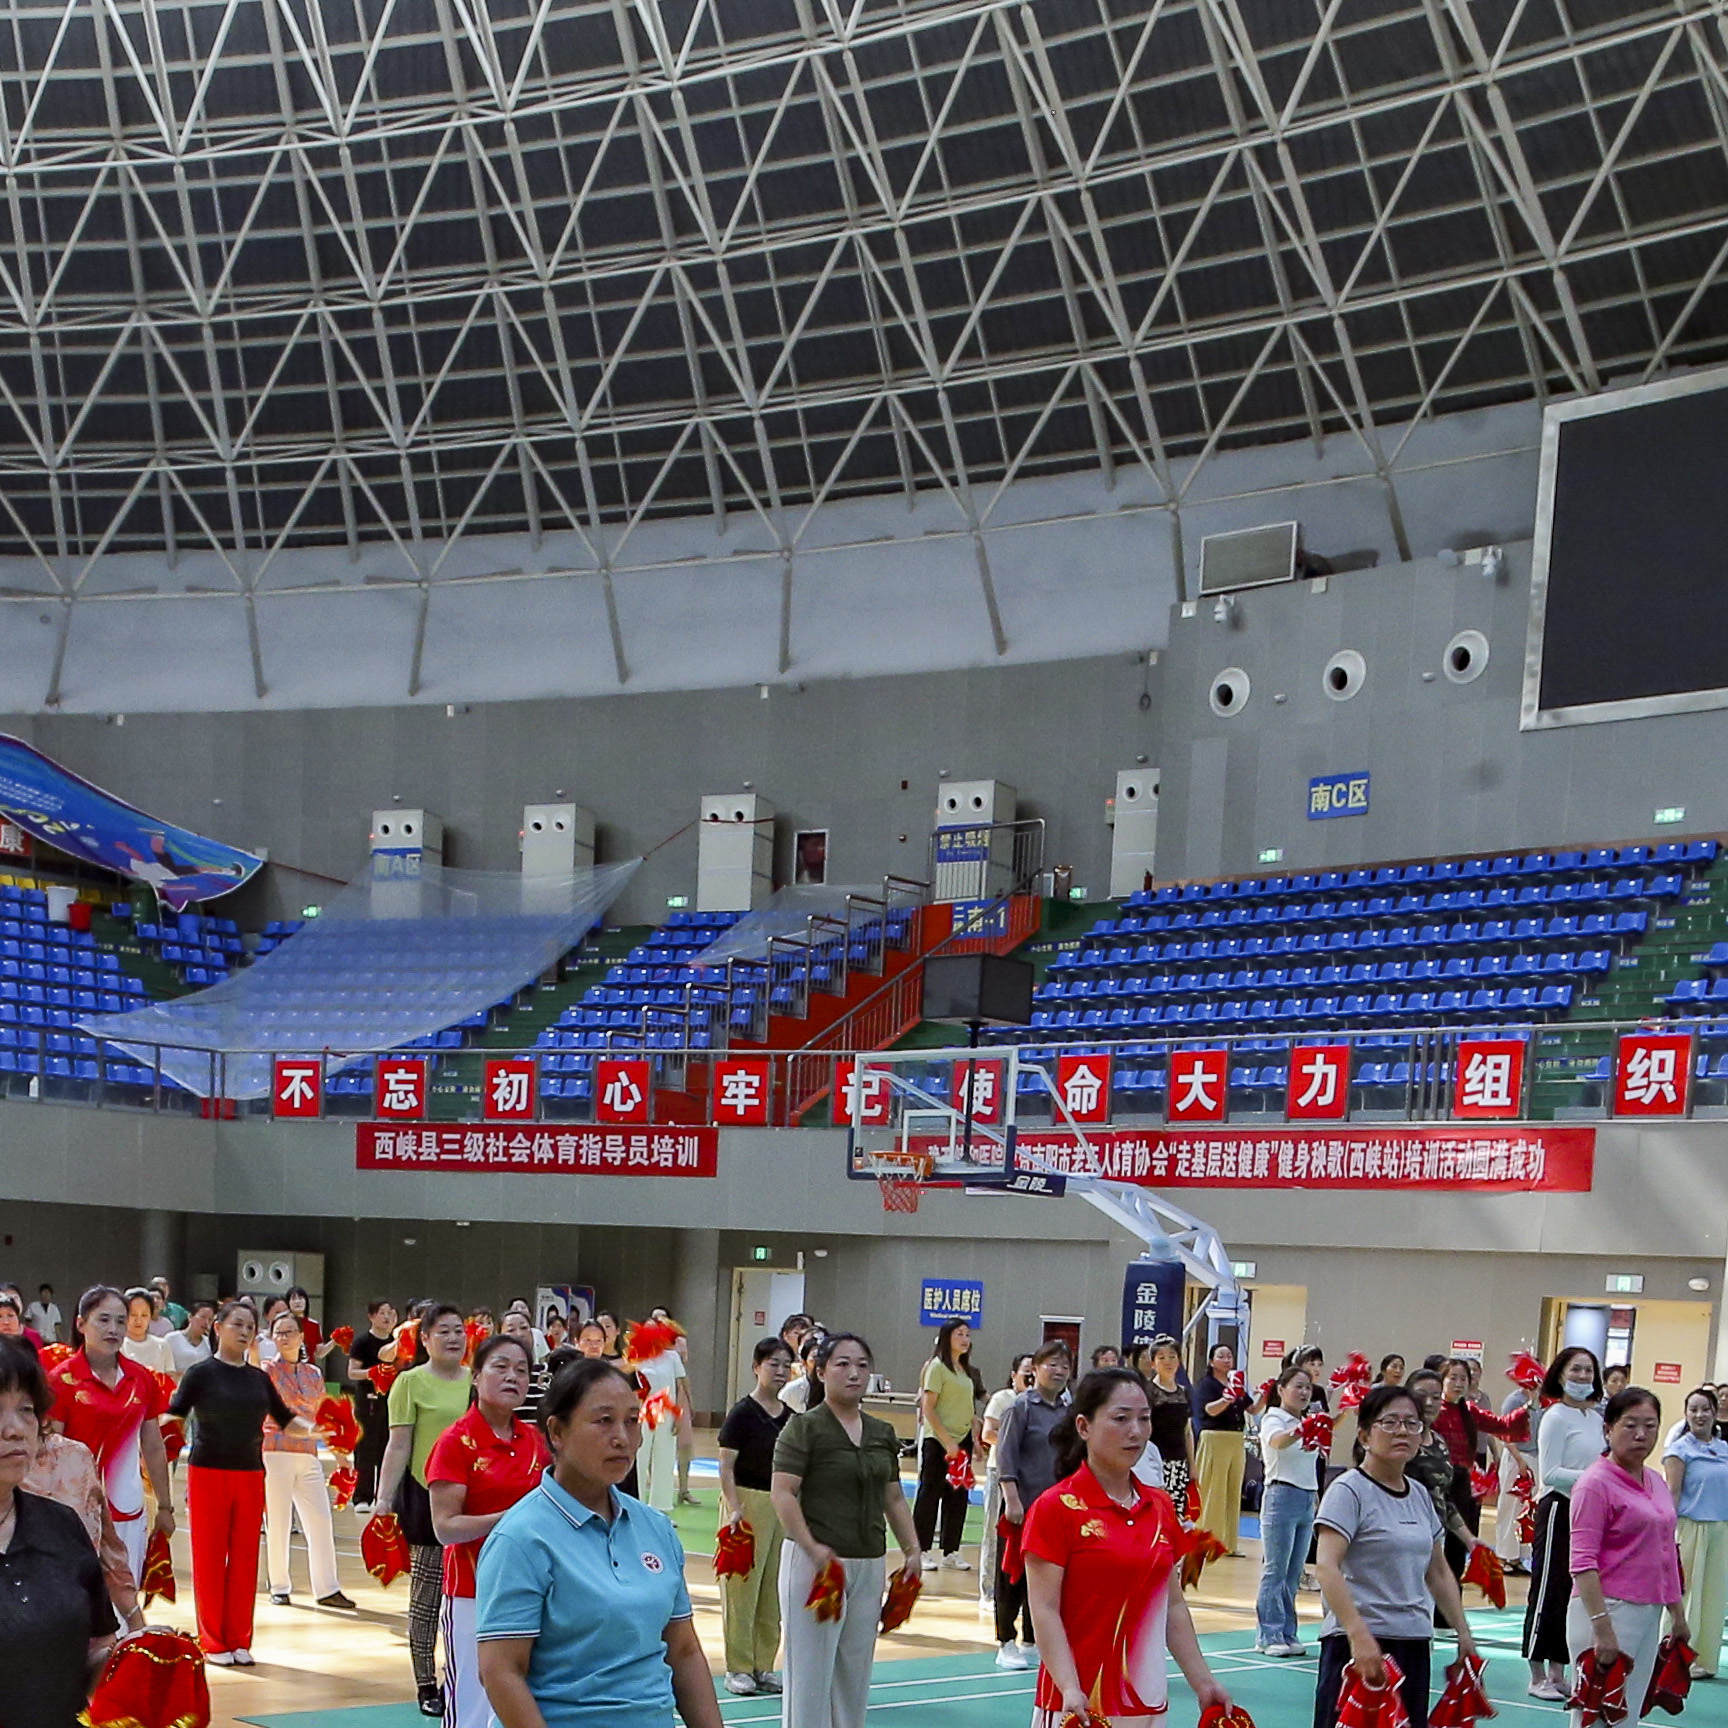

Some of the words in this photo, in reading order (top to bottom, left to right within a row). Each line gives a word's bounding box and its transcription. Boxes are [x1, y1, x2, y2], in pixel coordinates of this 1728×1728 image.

[1311, 779, 1369, 814] 南C区
[280, 1068, 314, 1108] 不
[383, 1068, 418, 1110] 忘
[492, 1068, 529, 1112] 初
[603, 1070, 642, 1112] 心
[720, 1069, 760, 1115] 牢
[958, 1068, 994, 1116] 使
[1063, 1064, 1103, 1115] 命
[1175, 1060, 1219, 1112] 大
[1297, 1053, 1338, 1107] 力
[1462, 1052, 1512, 1106] 组
[1624, 1047, 1677, 1105] 织
[374, 1131, 699, 1168] 西峡县三级社会体育指导员培训
[923, 1287, 981, 1313] 医护人员席位
